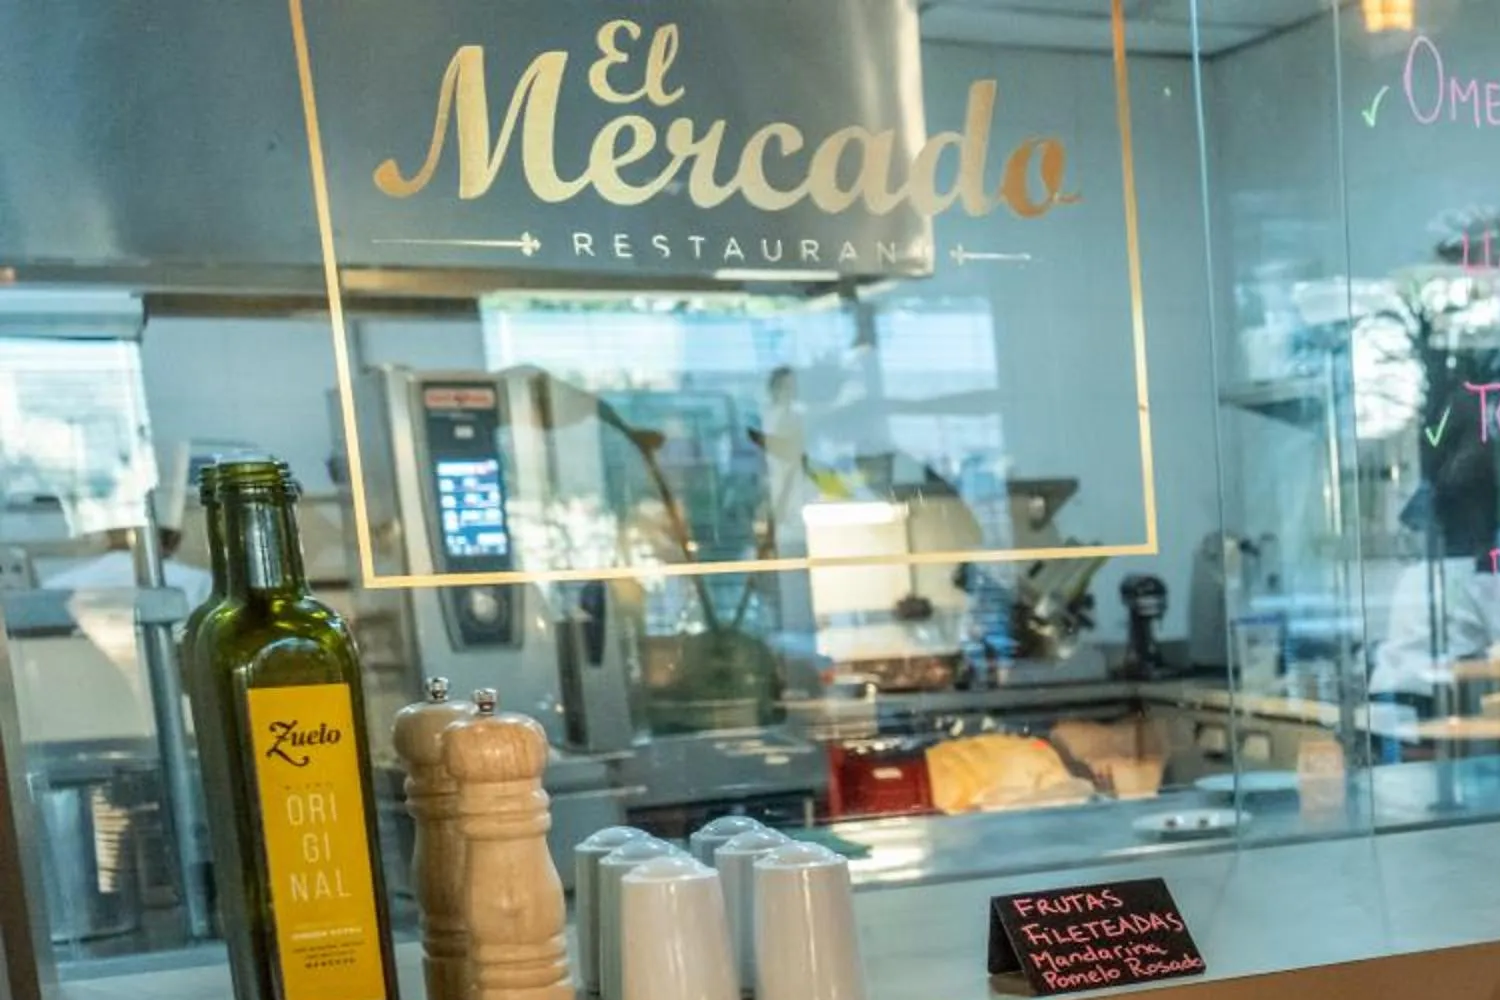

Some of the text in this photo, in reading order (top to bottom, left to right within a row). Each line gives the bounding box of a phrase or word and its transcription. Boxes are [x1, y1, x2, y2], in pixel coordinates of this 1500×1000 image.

[588, 18, 686, 107] El
[373, 45, 1084, 219] Mercado
[572, 231, 928, 270] RESTAURAN
[266, 719, 342, 768] Zuelo
[286, 792, 338, 827] ORI
[302, 830, 332, 864] GI
[289, 868, 353, 903] NAL
[1013, 888, 1124, 918] FRUTAS
[1030, 940, 1169, 973] Mandarina
[1042, 953, 1204, 990] Pomelo Rosado
